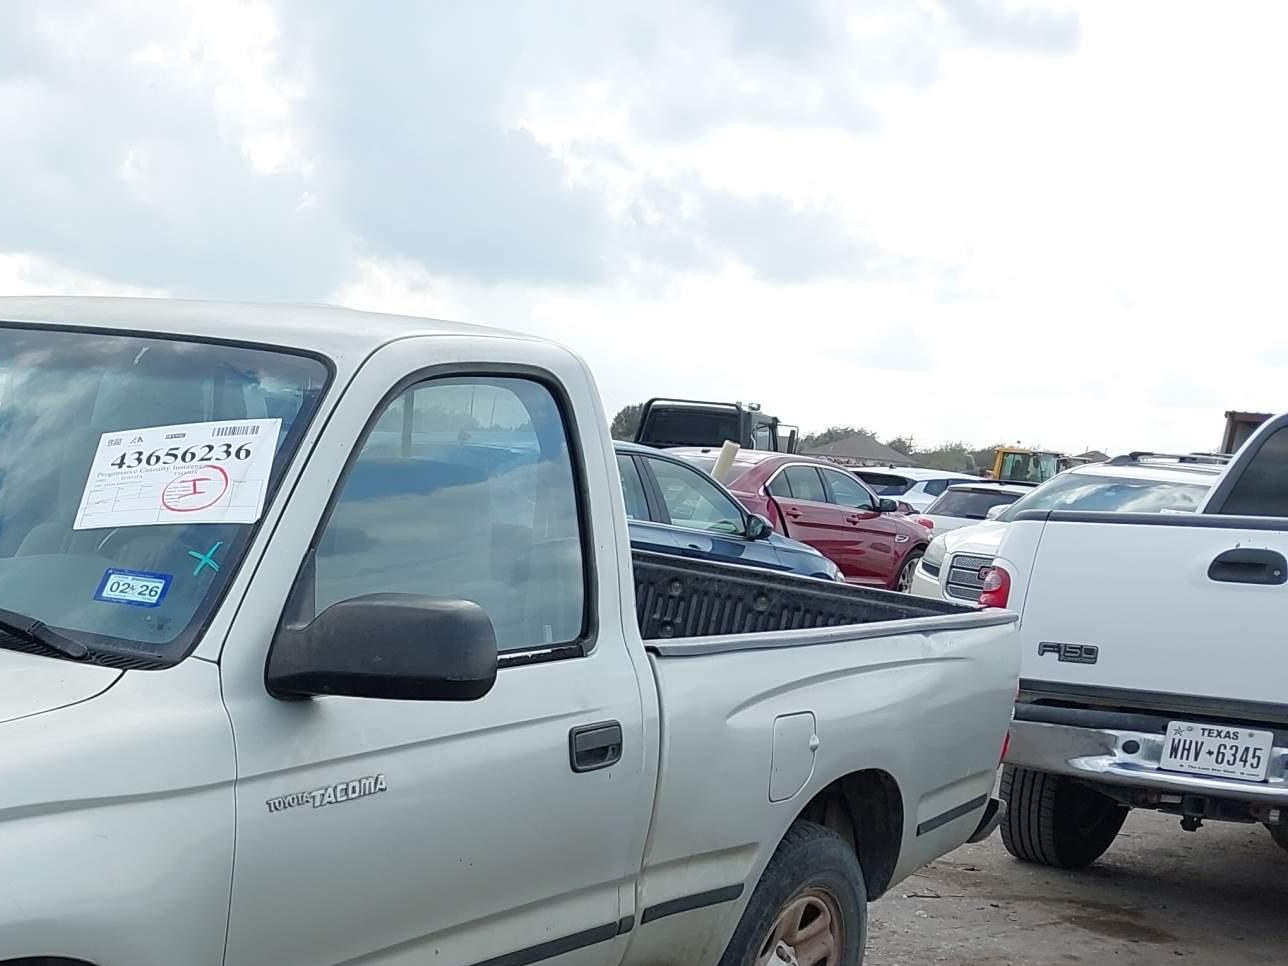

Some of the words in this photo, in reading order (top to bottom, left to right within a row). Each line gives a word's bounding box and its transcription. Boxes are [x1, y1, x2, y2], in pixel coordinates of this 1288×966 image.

[110, 441, 253, 469] 43656236
[109, 581, 131, 594] 02
[137, 584, 160, 598] 26
[1200, 727, 1240, 741] TEXAS
[266, 791, 312, 812] TOYOTA
[311, 773, 388, 809] TACOMA
